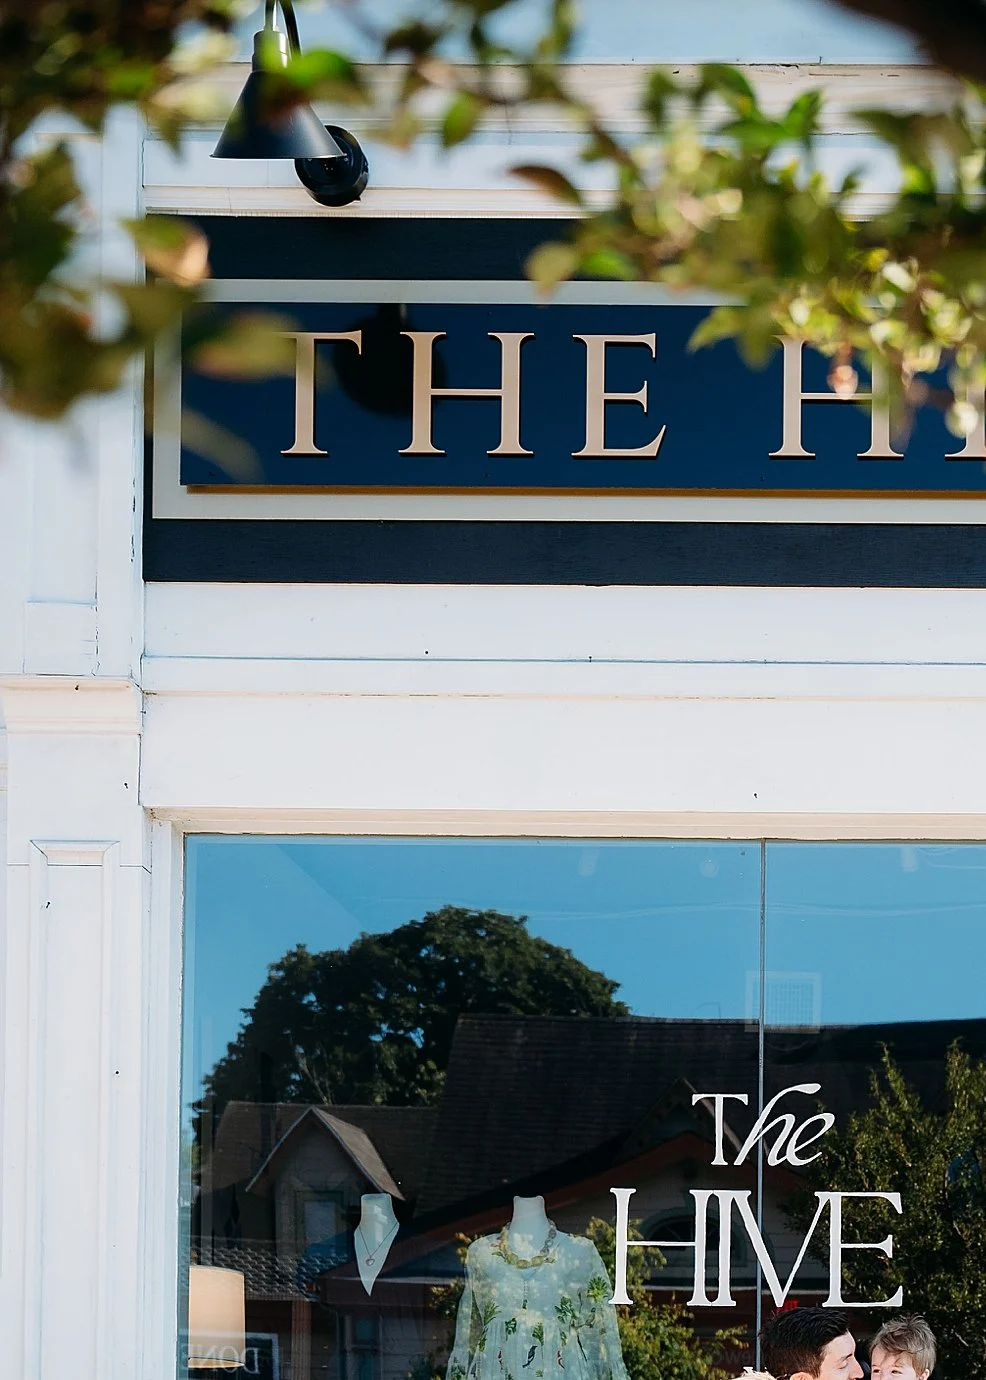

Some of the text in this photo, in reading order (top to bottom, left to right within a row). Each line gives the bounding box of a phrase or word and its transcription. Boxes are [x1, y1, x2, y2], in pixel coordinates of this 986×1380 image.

[272, 329, 668, 459] THE
[691, 1082, 836, 1167] The
[607, 1187, 904, 1309] HIVE
